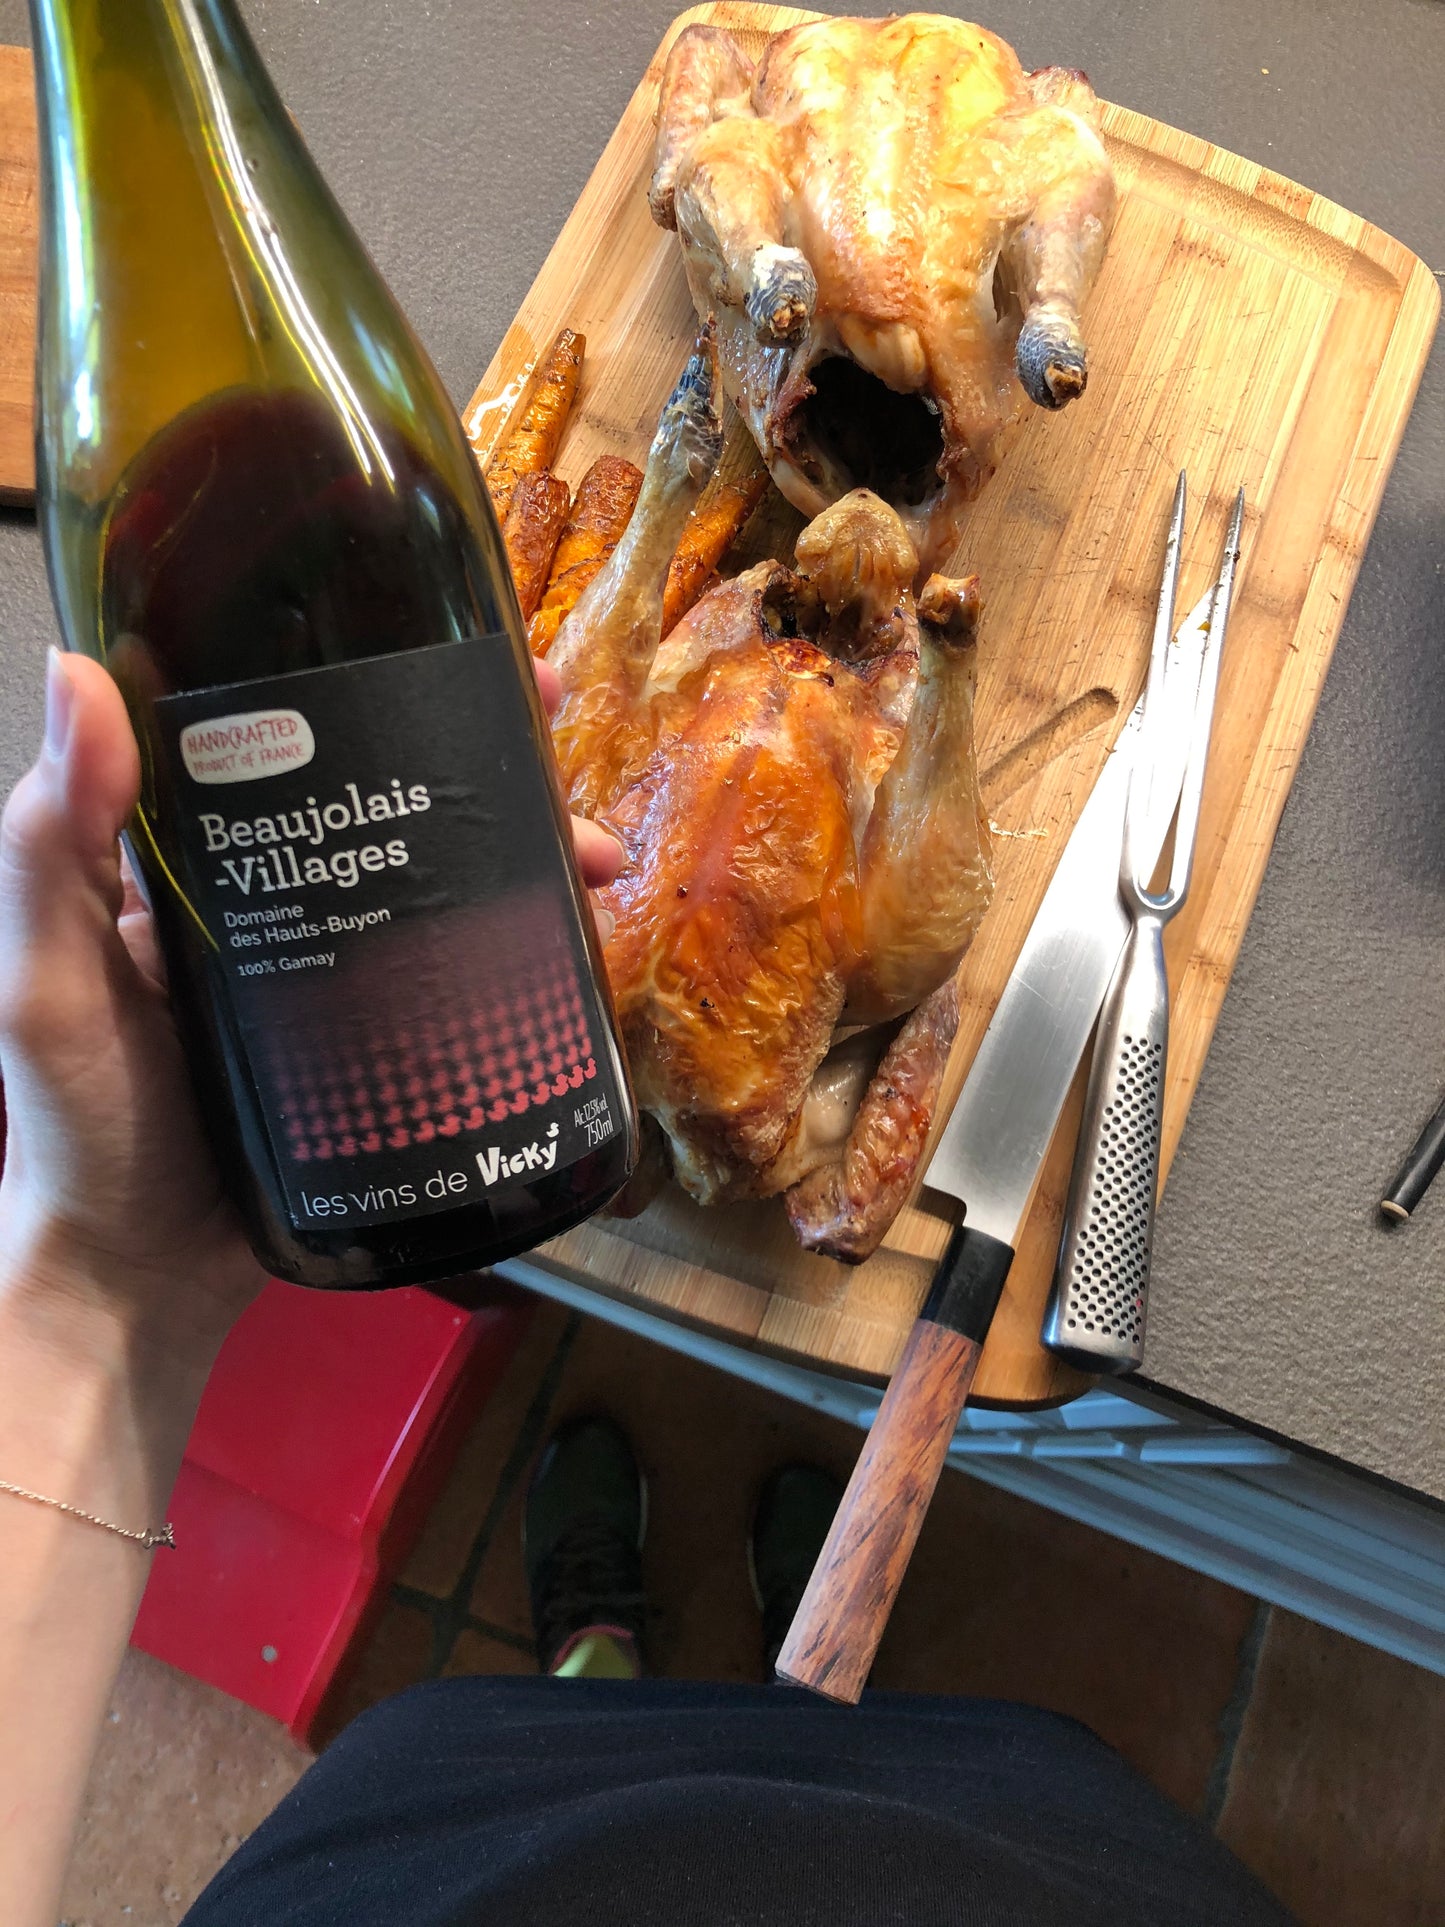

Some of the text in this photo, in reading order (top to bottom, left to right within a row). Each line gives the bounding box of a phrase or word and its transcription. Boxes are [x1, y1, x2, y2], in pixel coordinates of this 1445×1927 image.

[187, 718, 298, 753] HANDCRAFTED
[193, 744, 304, 775] PRODUCT OF FRANCE
[198, 778, 432, 852] Beaujolais
[215, 839, 410, 895] -Villages
[223, 904, 305, 928] Domaine
[230, 908, 391, 948] des Hauts-Buyon
[238, 952, 336, 976] 100% Gamay
[583, 1110, 614, 1147] 750ml
[301, 1141, 559, 1217] les vins de Vicky
